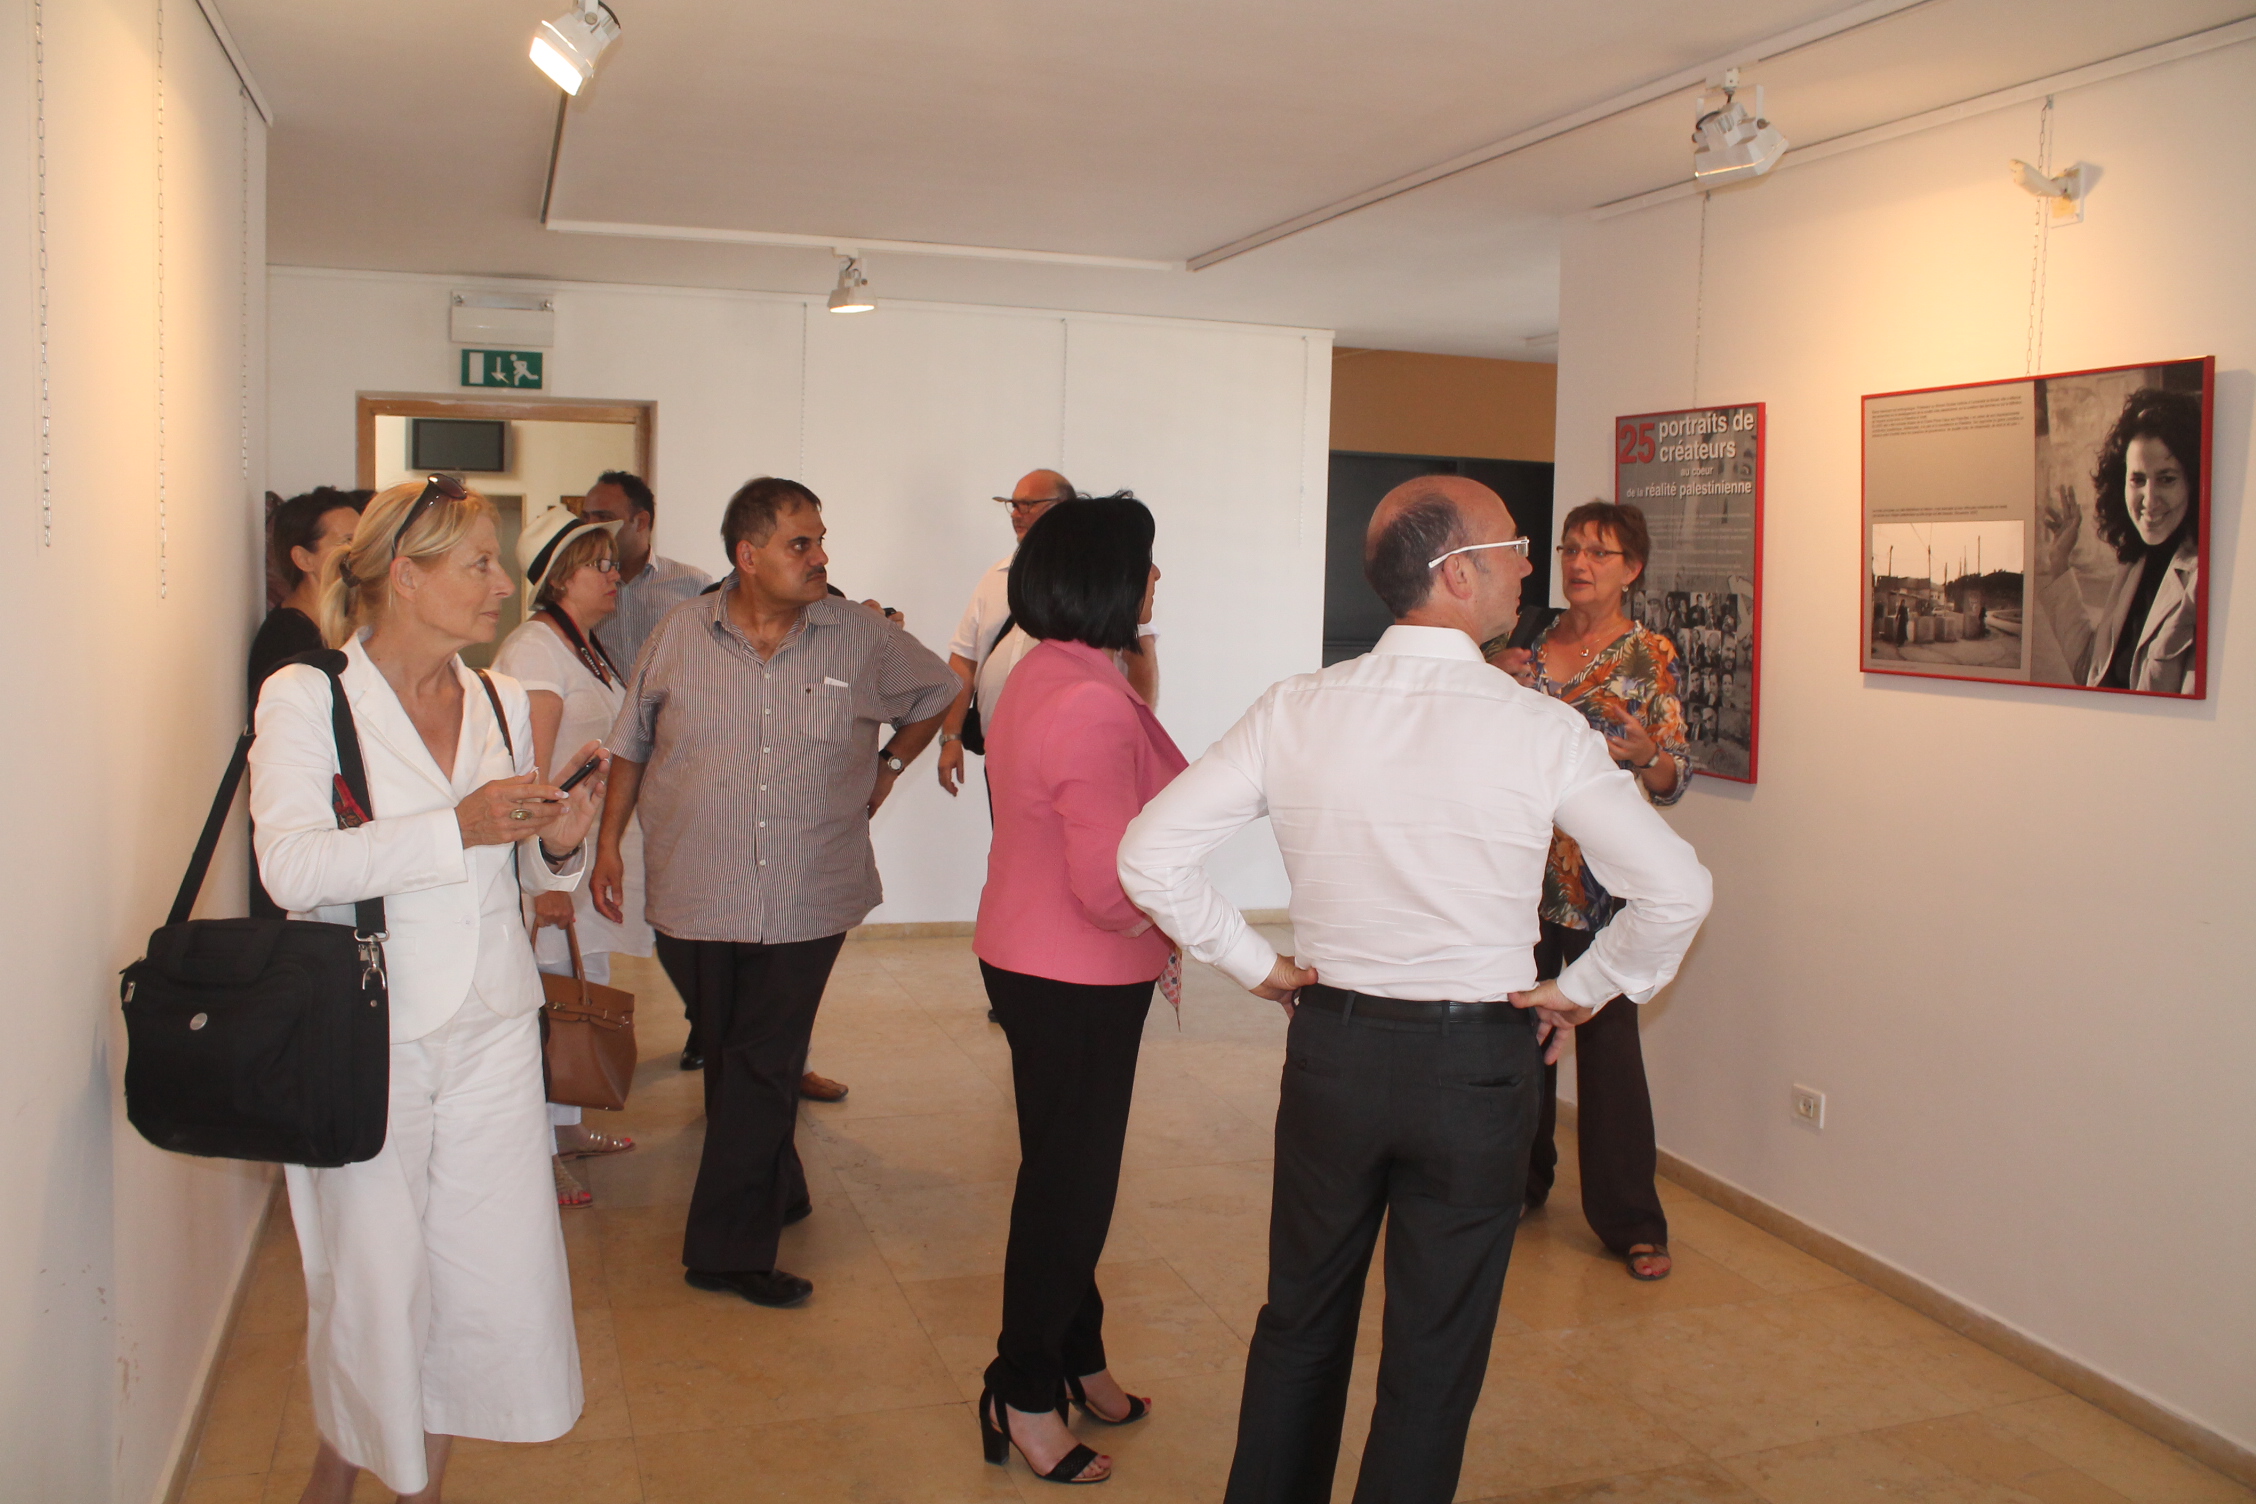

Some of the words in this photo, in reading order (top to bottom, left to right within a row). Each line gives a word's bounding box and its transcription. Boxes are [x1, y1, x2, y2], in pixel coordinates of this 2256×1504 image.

[1620, 423, 1656, 464] 25
[1659, 412, 1728, 443] portraits
[1733, 409, 1755, 432] de
[1659, 439, 1737, 463] créateurs
[1680, 467, 1690, 477] au
[1691, 466, 1714, 477] coeur
[1626, 488, 1635, 498] de
[1636, 487, 1644, 497] la
[1645, 481, 1677, 498] réalité
[1680, 480, 1753, 500] palestinienne
